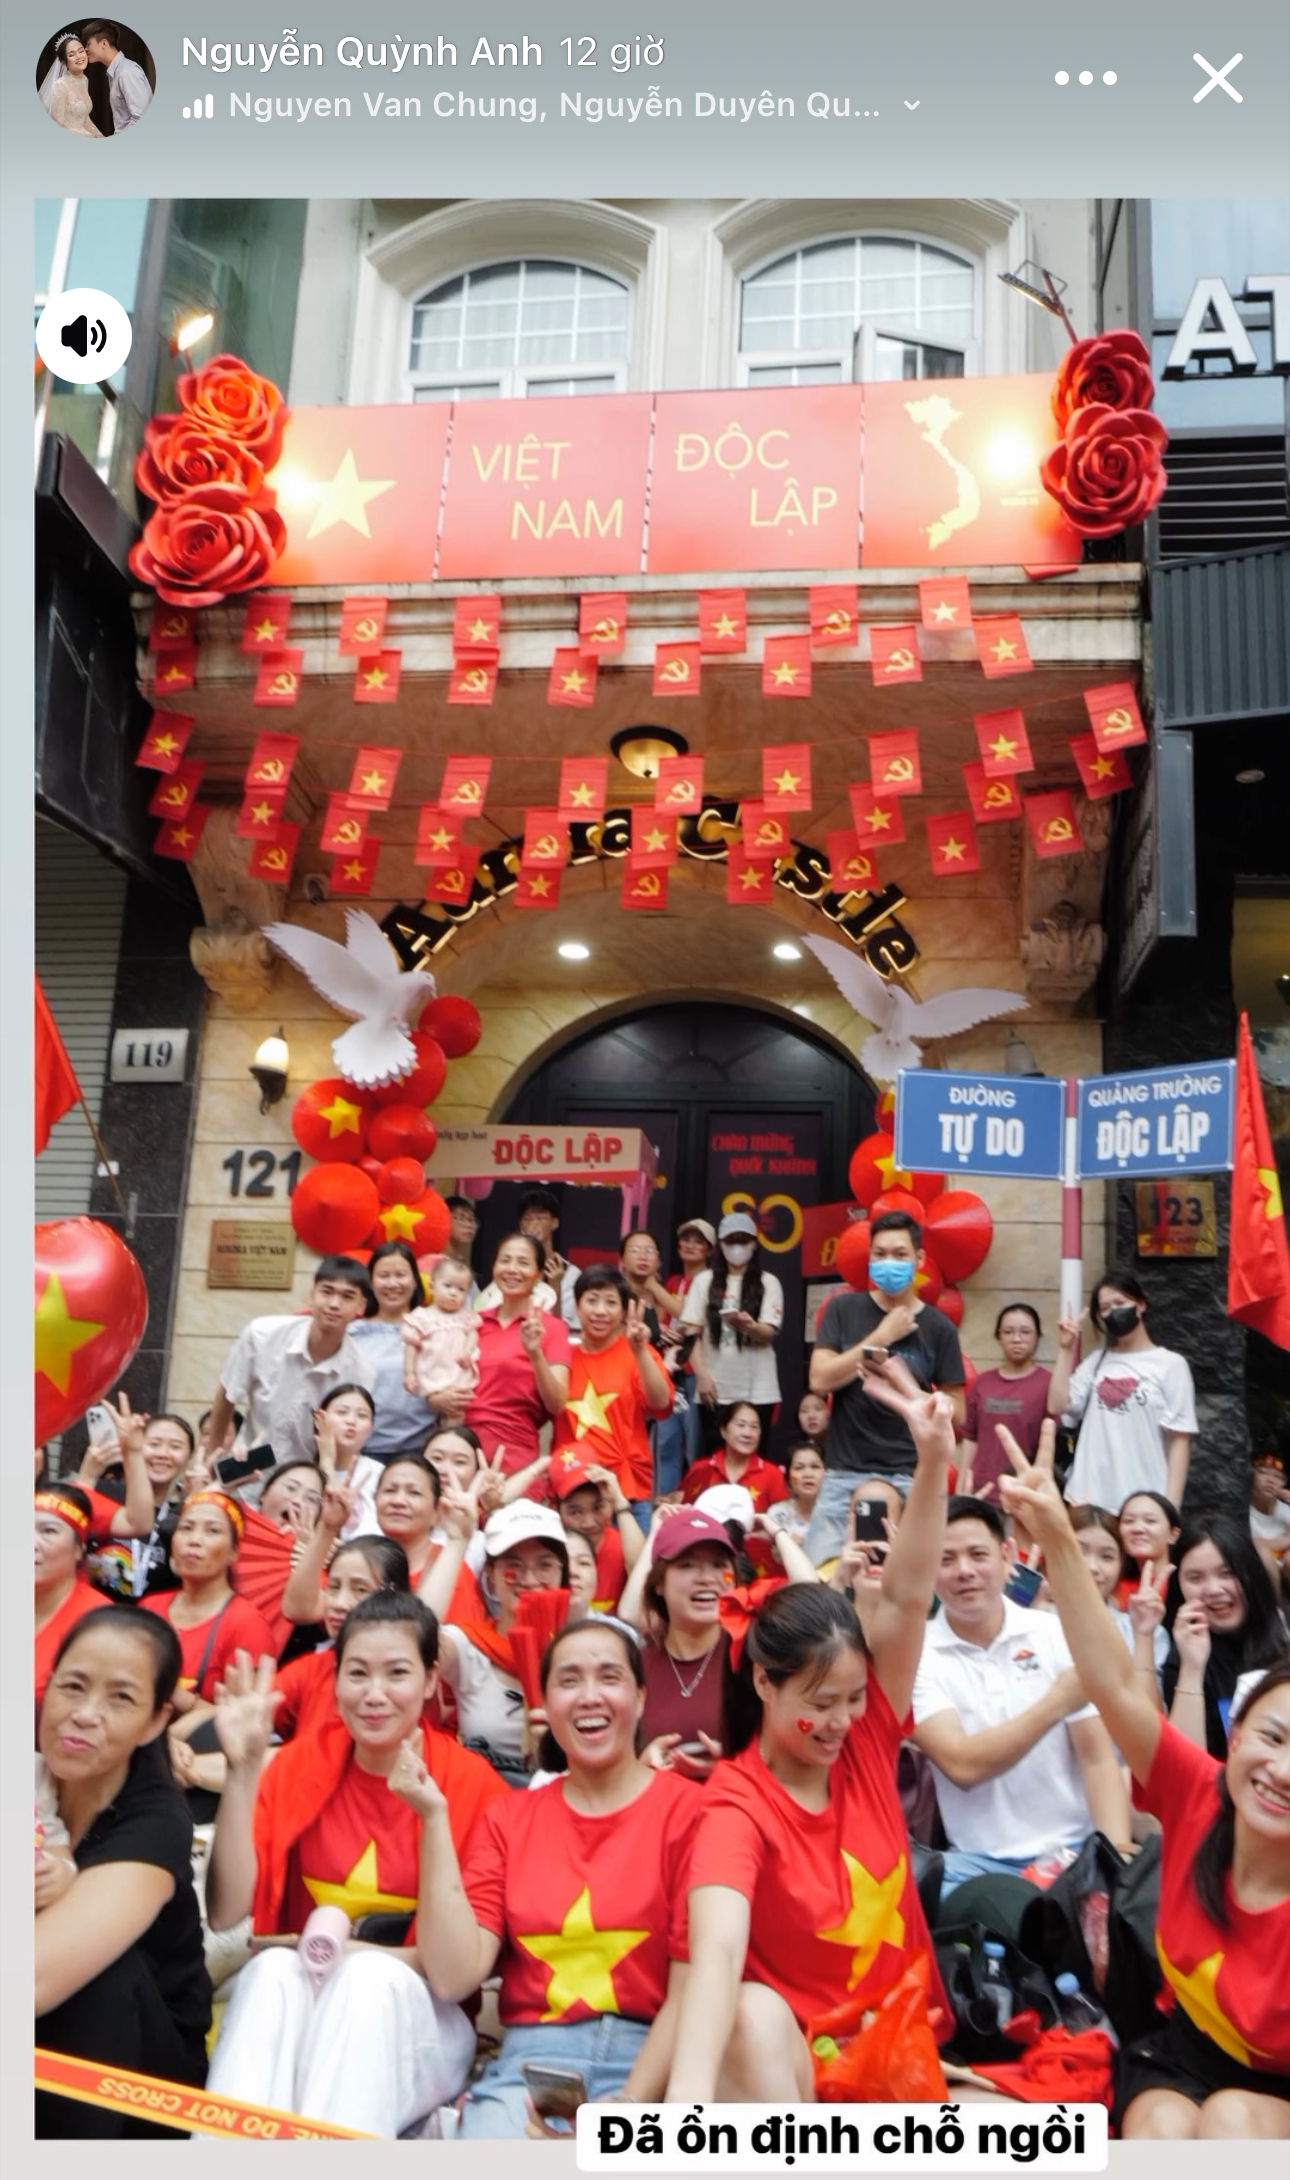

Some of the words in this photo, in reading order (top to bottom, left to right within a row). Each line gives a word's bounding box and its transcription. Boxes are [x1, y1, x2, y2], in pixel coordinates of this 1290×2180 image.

[471, 434, 572, 491] VIỆT
[673, 424, 790, 479] ĐỘC
[510, 499, 624, 540] NAM
[749, 478, 838, 535] LẬP
[123, 1040, 174, 1069] 119
[948, 1083, 1016, 1108] ĐƯỜNG
[1088, 1080, 1149, 1108] QUẢNG
[1152, 1075, 1222, 1100] TRƯỜNG
[492, 1133, 555, 1170] ĐỘC
[564, 1131, 622, 1169] LẬP
[938, 1112, 978, 1163] TỰ
[986, 1117, 1024, 1157] DO
[1096, 1110, 1150, 1167] ĐỘC
[1157, 1104, 1210, 1162] LẬP
[222, 1149, 301, 1198] 121
[1149, 1196, 1204, 1226] 123
[97, 2077, 182, 2112] CROSS
[184, 2101, 239, 2129] NOT
[242, 2115, 281, 2139] DO
